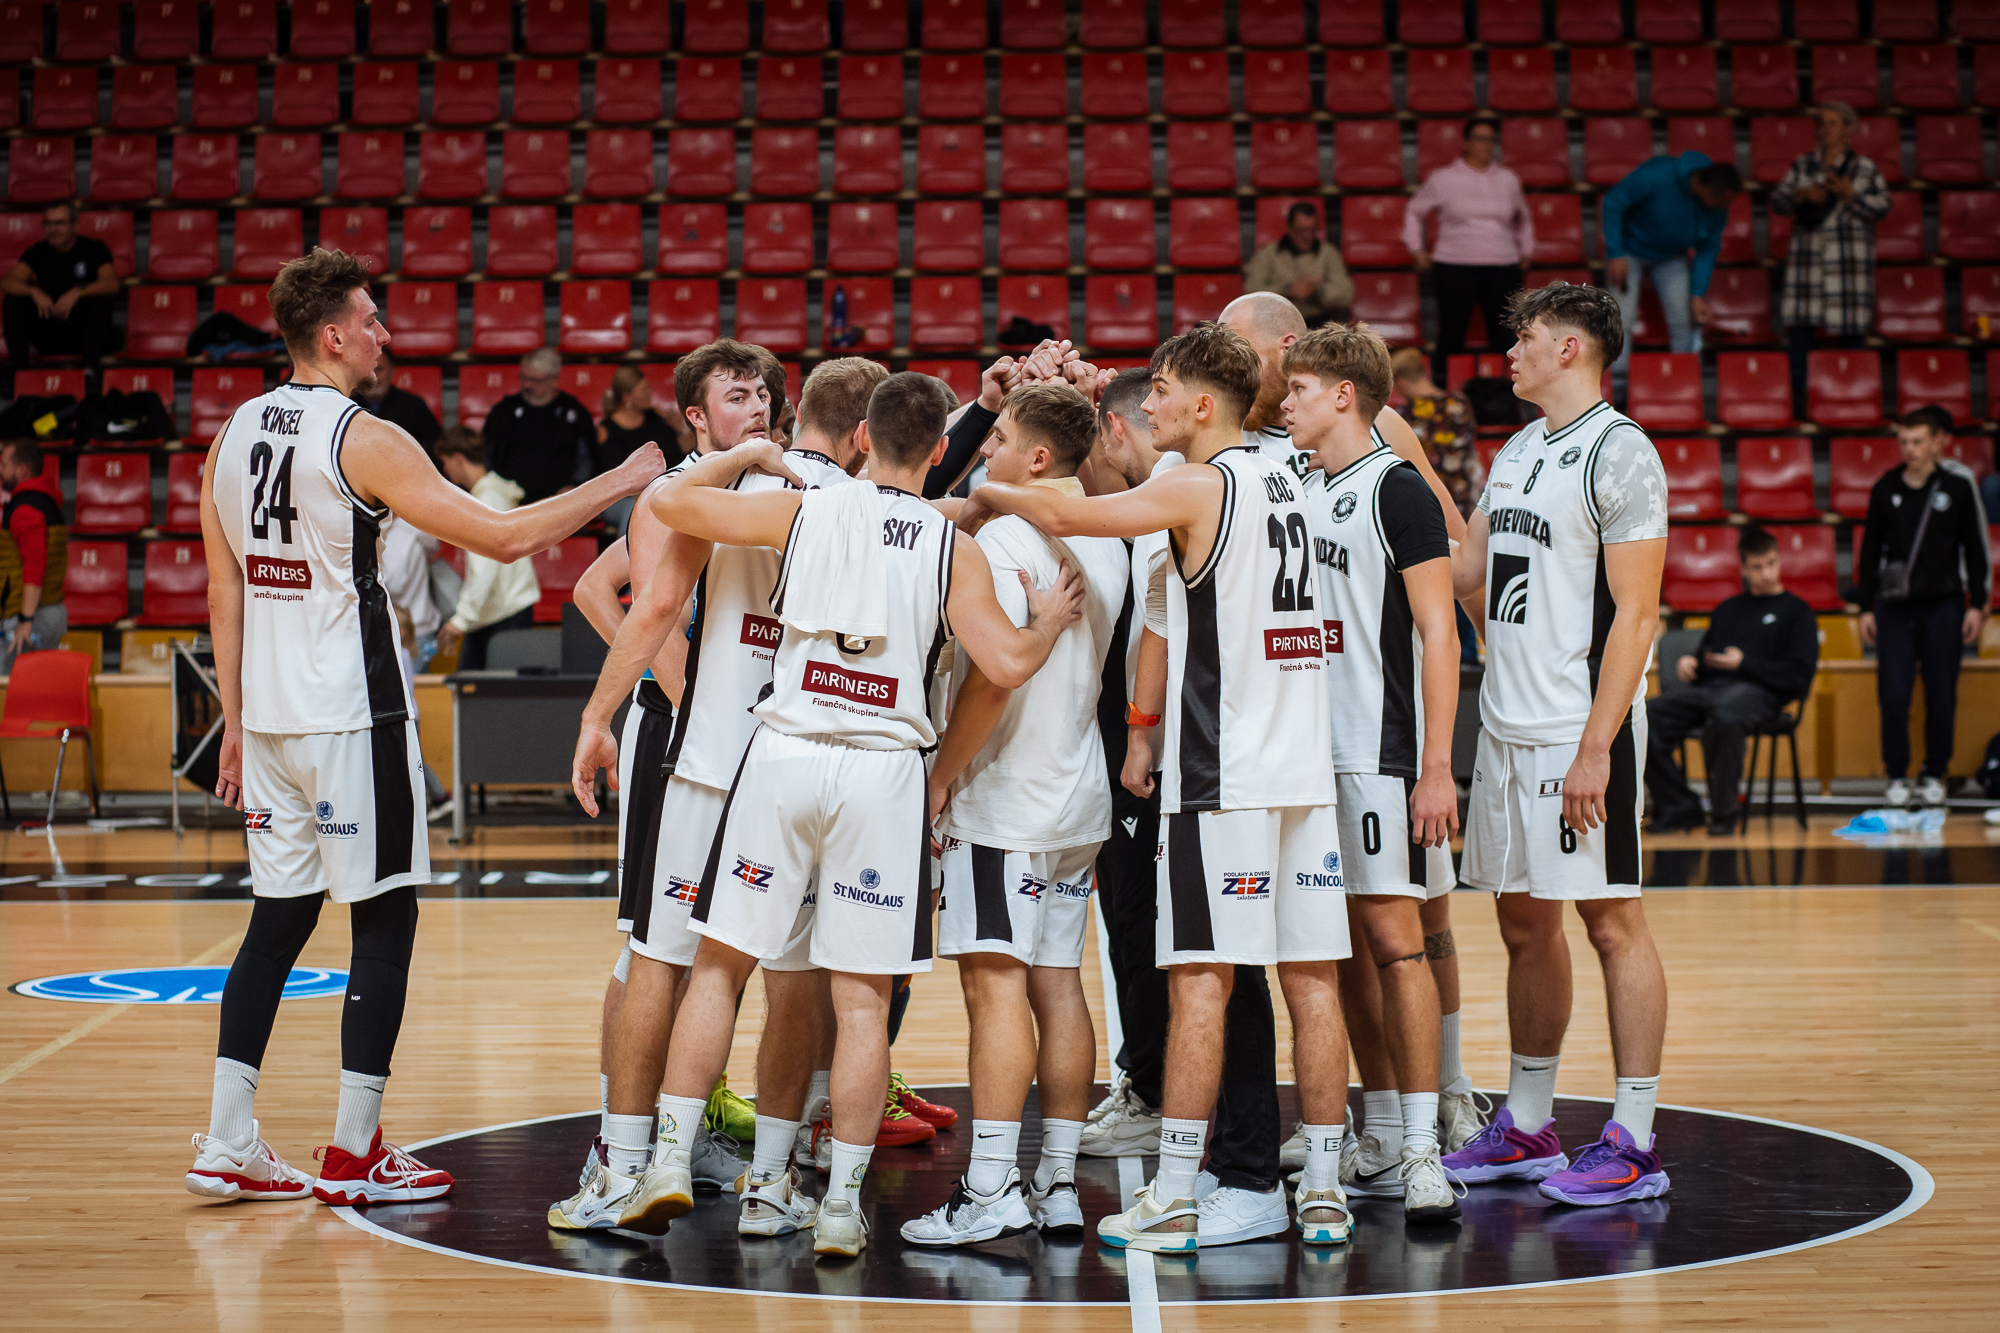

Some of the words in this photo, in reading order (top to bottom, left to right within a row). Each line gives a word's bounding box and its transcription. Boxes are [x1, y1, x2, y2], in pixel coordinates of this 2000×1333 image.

[250, 440, 298, 544] 24
[1523, 458, 1544, 495] 8
[884, 517, 924, 551] SKÝ
[1267, 512, 1314, 612] 22
[810, 669, 890, 699] PARTNERS
[812, 697, 847, 711] Finančná
[1361, 811, 1382, 856] 0
[1559, 812, 1578, 855] 8
